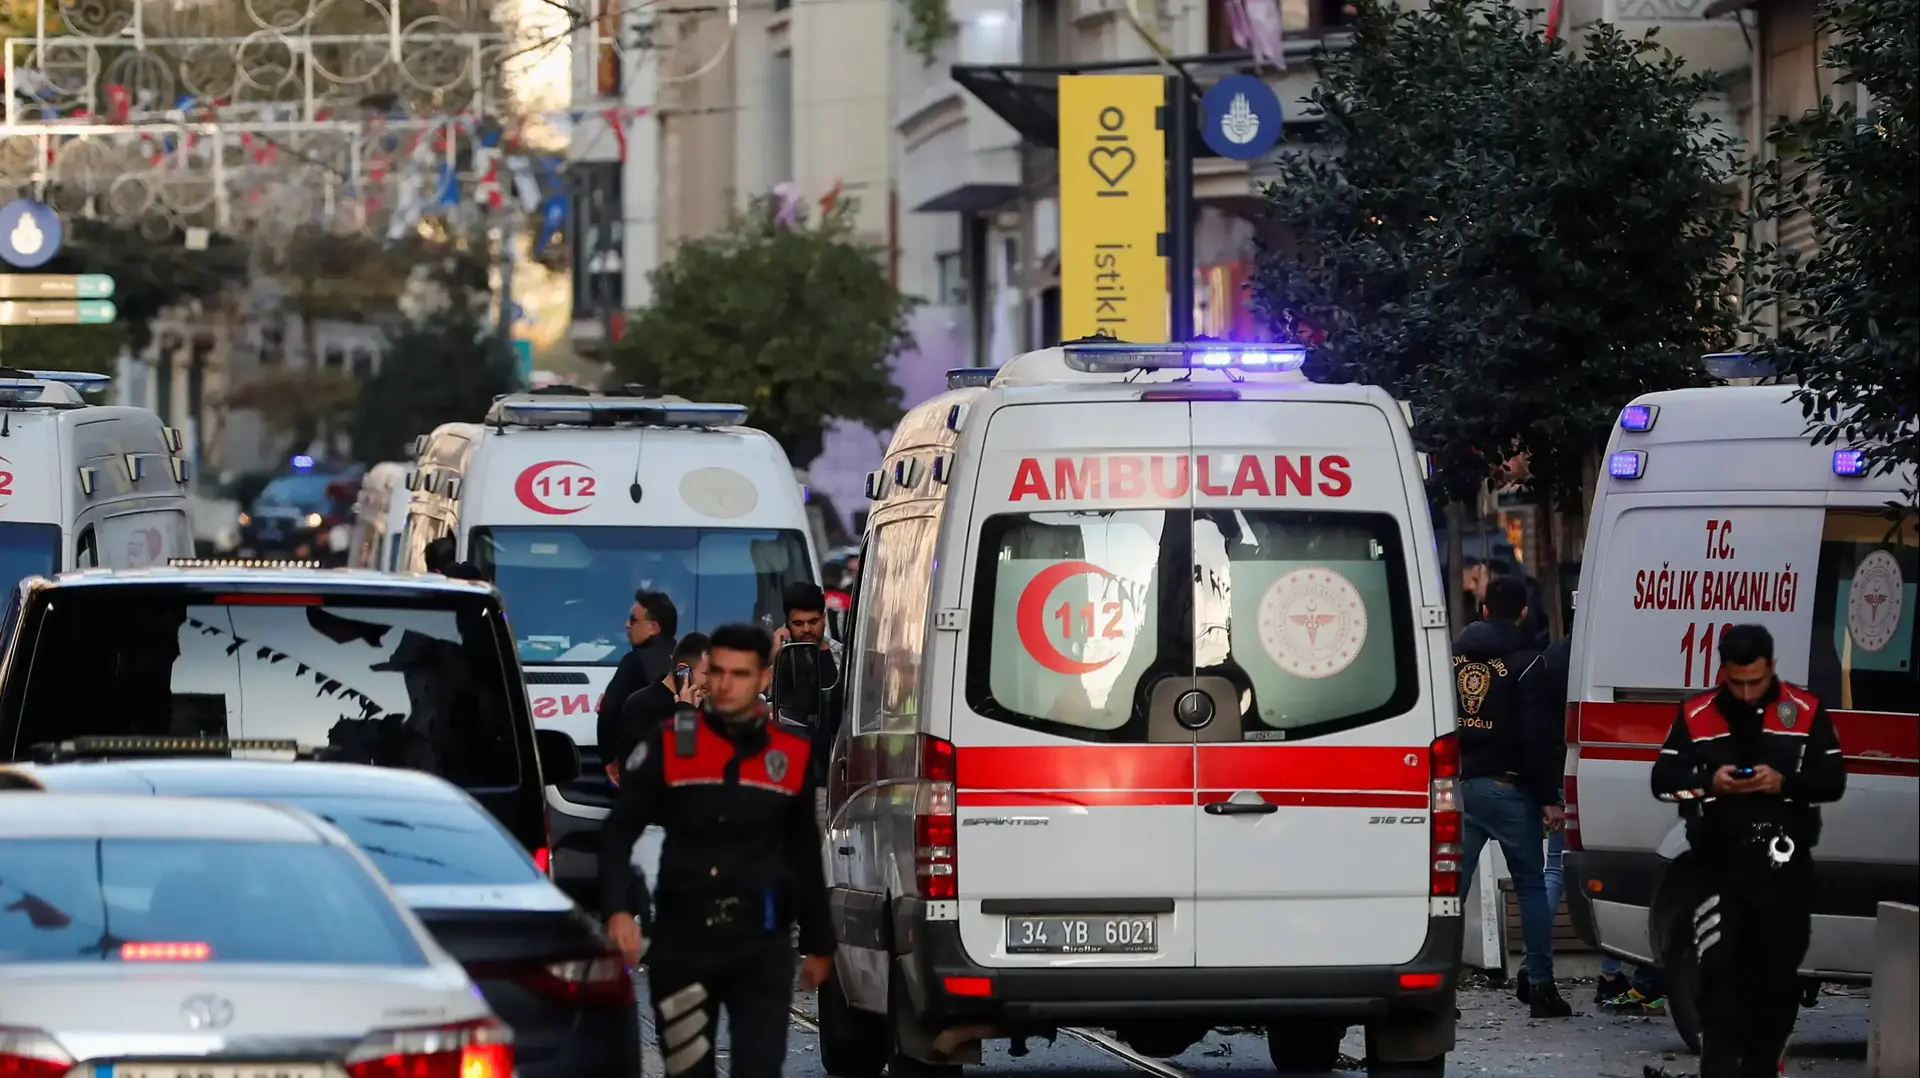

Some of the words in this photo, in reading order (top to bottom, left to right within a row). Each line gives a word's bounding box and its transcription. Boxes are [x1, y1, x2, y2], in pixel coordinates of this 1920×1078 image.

[536, 476, 596, 496] 112
[1008, 454, 1353, 501] AMBULANS
[1706, 520, 1735, 559] T.C.
[1634, 561, 1698, 609] SAĞLIK
[1701, 563, 1798, 612] BAKANLIĞI
[1055, 601, 1124, 638] 112
[1458, 716, 1493, 729] EYOĞLU
[1368, 816, 1397, 824] 316
[1400, 816, 1426, 824] CDI
[1022, 921, 1047, 944] 34
[1062, 920, 1088, 944] YB
[1105, 920, 1154, 944] 6021
